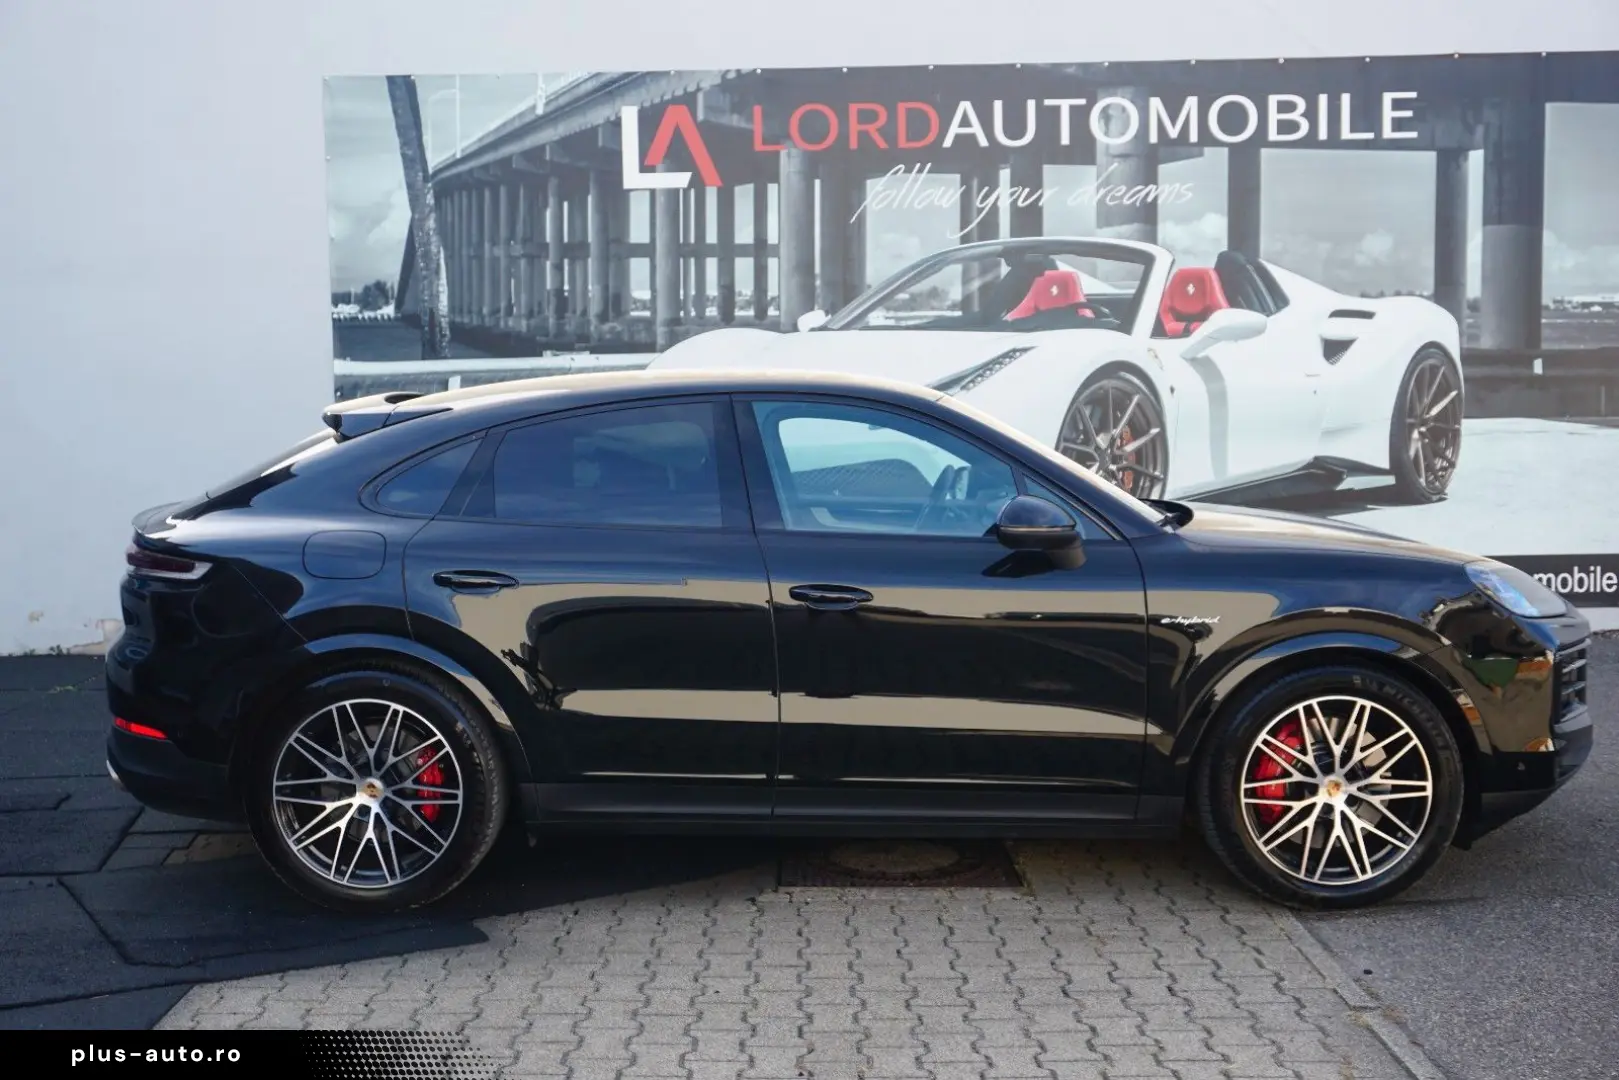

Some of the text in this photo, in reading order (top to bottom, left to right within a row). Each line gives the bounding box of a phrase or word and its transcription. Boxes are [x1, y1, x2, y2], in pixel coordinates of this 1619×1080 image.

[752, 90, 1419, 152] LORDAUTOMOBILE
[850, 163, 1193, 239] follow your dreams
